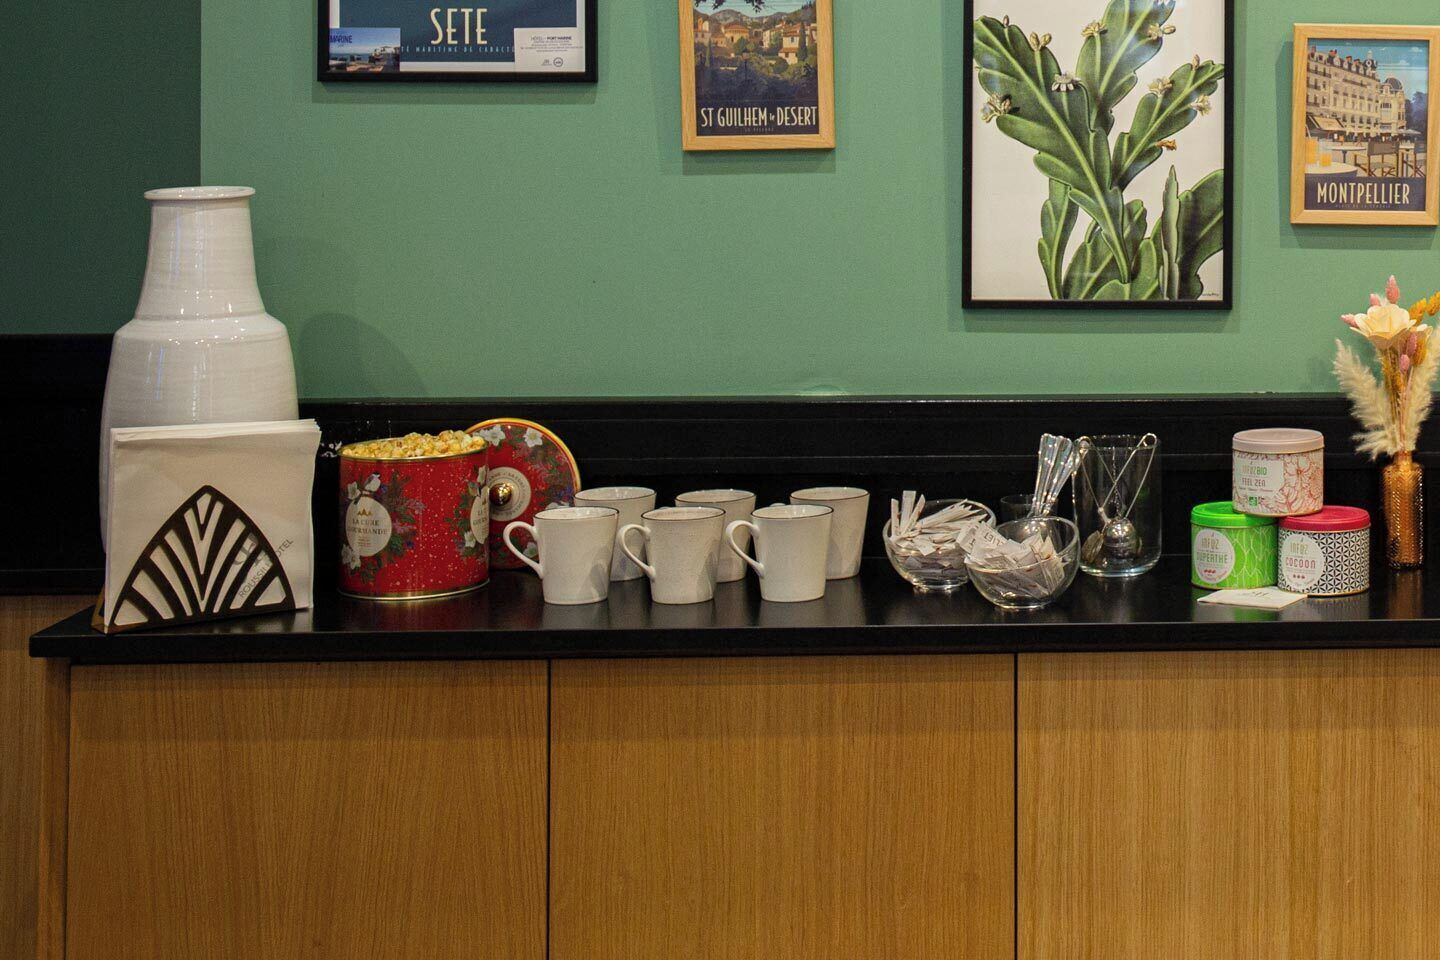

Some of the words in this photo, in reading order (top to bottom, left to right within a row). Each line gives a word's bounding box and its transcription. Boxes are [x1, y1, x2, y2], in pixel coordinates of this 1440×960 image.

[430, 8, 488, 45] SETE
[701, 107, 714, 127] ST
[717, 106, 767, 127] GUILHEM
[777, 106, 817, 126] DESERT
[1317, 182, 1410, 204] MONTPELLIER
